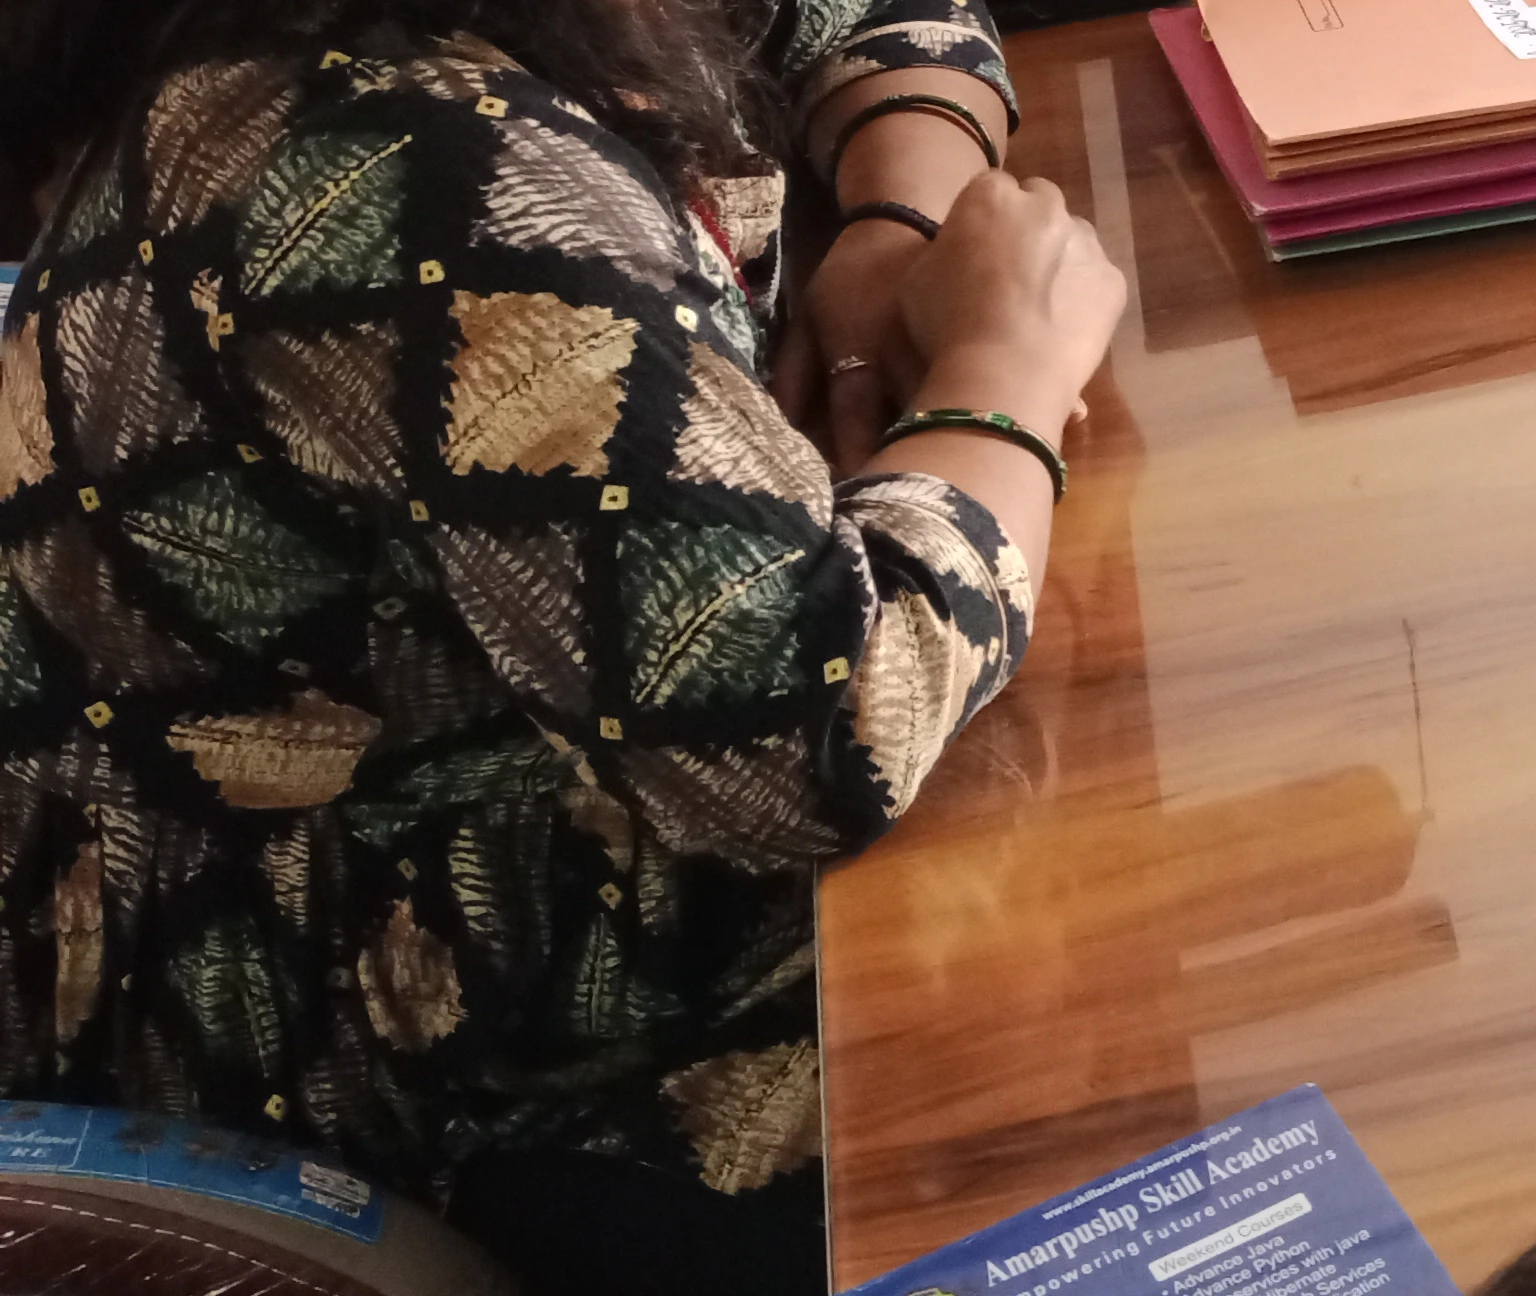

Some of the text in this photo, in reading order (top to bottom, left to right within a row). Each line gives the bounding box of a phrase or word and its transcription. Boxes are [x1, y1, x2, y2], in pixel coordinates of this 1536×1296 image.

[985, 1117, 1321, 1288] Amarpushp Skill Academy
[1141, 1202, 1217, 1247] Future
[1218, 1147, 1339, 1211] Innovators
[1158, 1200, 1303, 1275] Weekend Courses
[1247, 1234, 1286, 1261] Java
[1252, 1240, 1311, 1275] Python
[1300, 1245, 1335, 1269] with
[1334, 1228, 1372, 1256] java
[1315, 1256, 1387, 1296] Services
